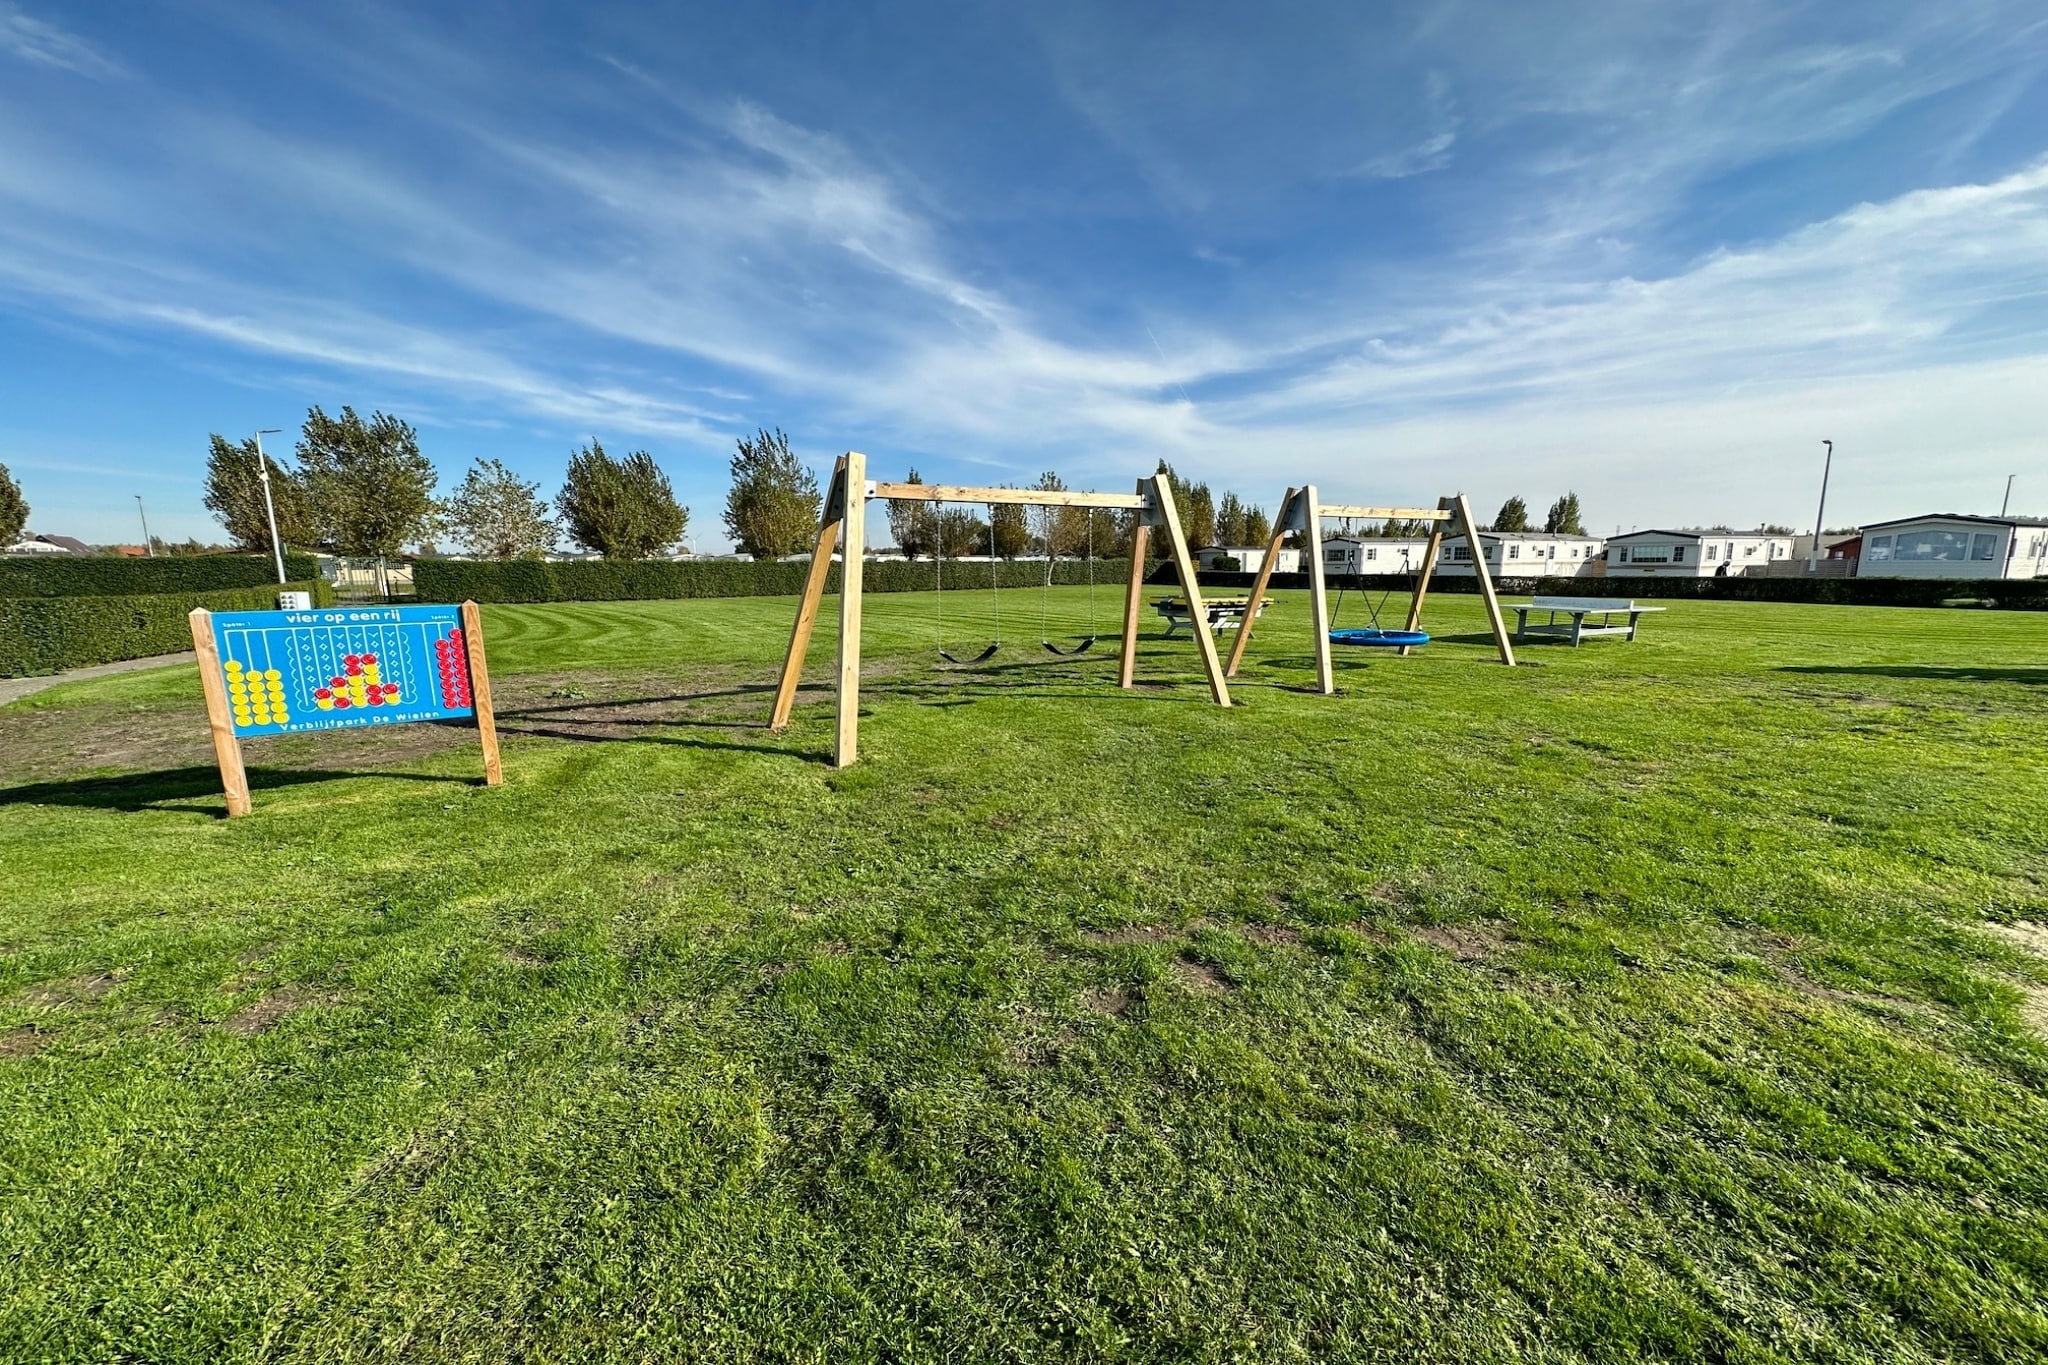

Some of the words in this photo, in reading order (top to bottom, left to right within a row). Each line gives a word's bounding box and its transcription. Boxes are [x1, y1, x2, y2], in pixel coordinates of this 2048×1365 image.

[286, 612, 319, 623] vier
[324, 613, 345, 624] op
[349, 612, 380, 621] een
[384, 609, 401, 622] rij
[279, 716, 368, 731] Verblijfpark
[373, 715, 389, 723] De
[395, 711, 439, 721] Wielen
